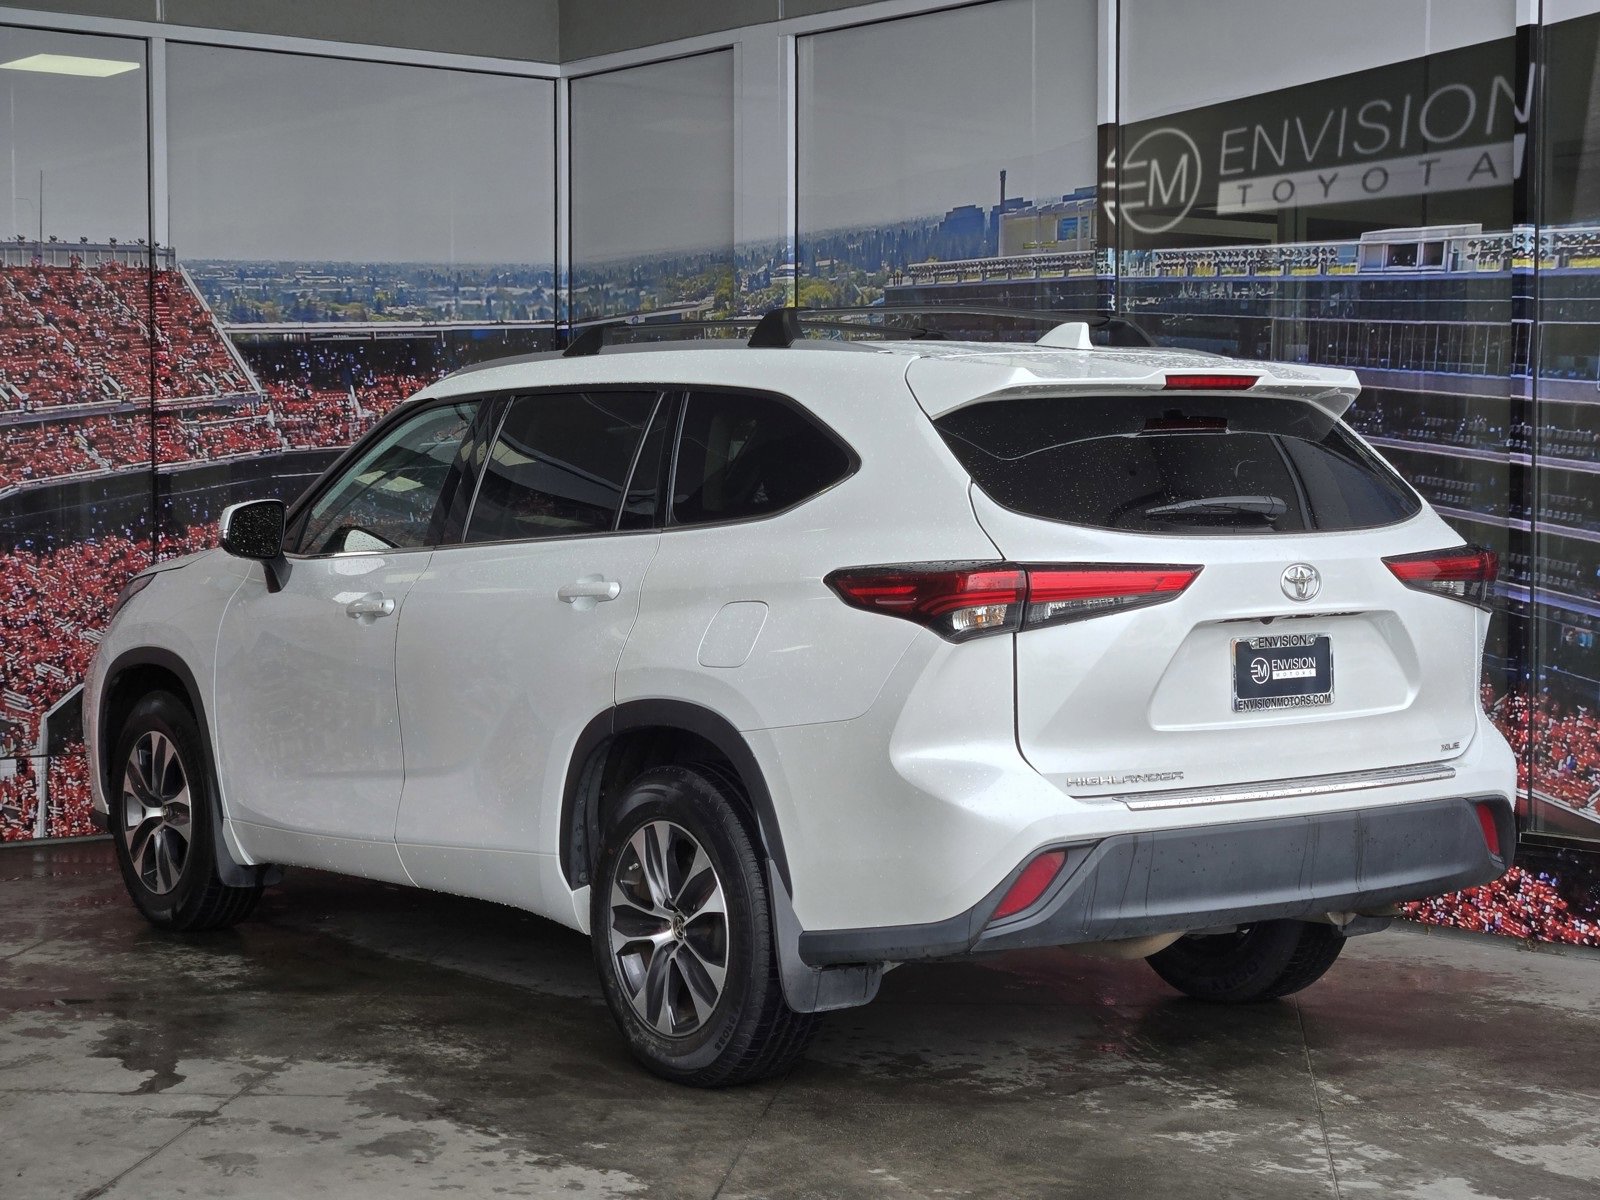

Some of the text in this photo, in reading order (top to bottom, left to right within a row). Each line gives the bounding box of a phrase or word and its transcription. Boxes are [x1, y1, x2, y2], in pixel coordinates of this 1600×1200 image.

[1219, 62, 1536, 176] ENVISION
[1237, 151, 1499, 207] TOYOTA
[1258, 634, 1307, 648] ENVISION
[1271, 657, 1316, 671] ENVISION
[1238, 693, 1331, 710] ENVISIONMOTORS.COM
[1440, 741, 1460, 752] XLE
[1066, 771, 1184, 787] HIGHLANDER
